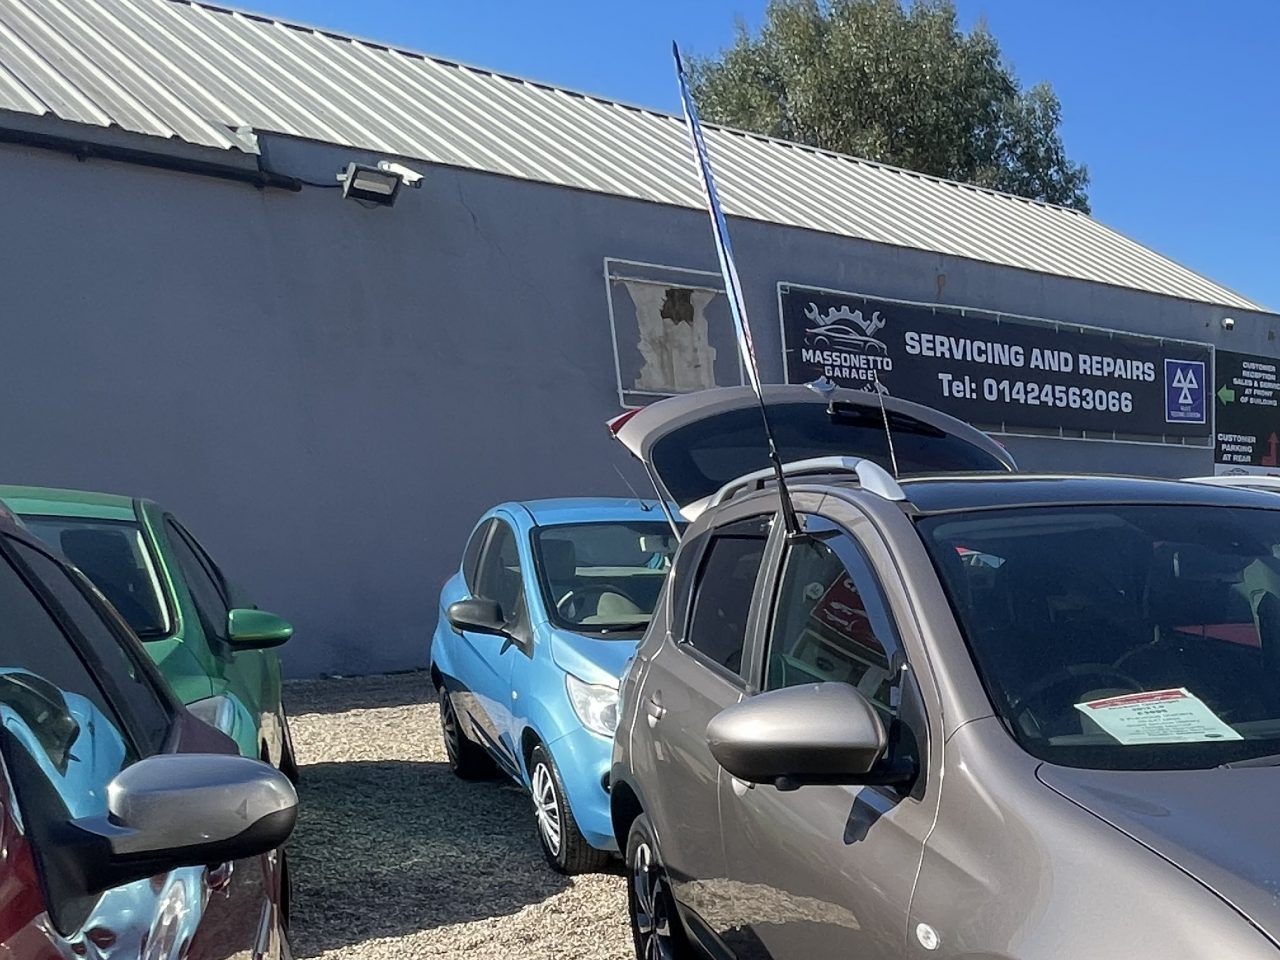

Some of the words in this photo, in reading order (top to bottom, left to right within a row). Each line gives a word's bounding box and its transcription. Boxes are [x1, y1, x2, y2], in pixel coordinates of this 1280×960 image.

[801, 348, 893, 371] MASSONETTO
[905, 331, 1025, 367] SERVICING
[1030, 348, 1073, 372] AND
[1078, 354, 1155, 382] REPAIRS
[1242, 361, 1276, 372] CUSTOMER
[824, 366, 875, 381] GARAGE
[1242, 370, 1276, 381] RECEPTION
[938, 373, 977, 399] Tel:
[983, 378, 1133, 413] 01424563066
[1217, 433, 1256, 443] CUSTOMER
[1221, 443, 1253, 453] PARKING
[1222, 453, 1231, 461] AT
[1233, 454, 1251, 462] REAR
